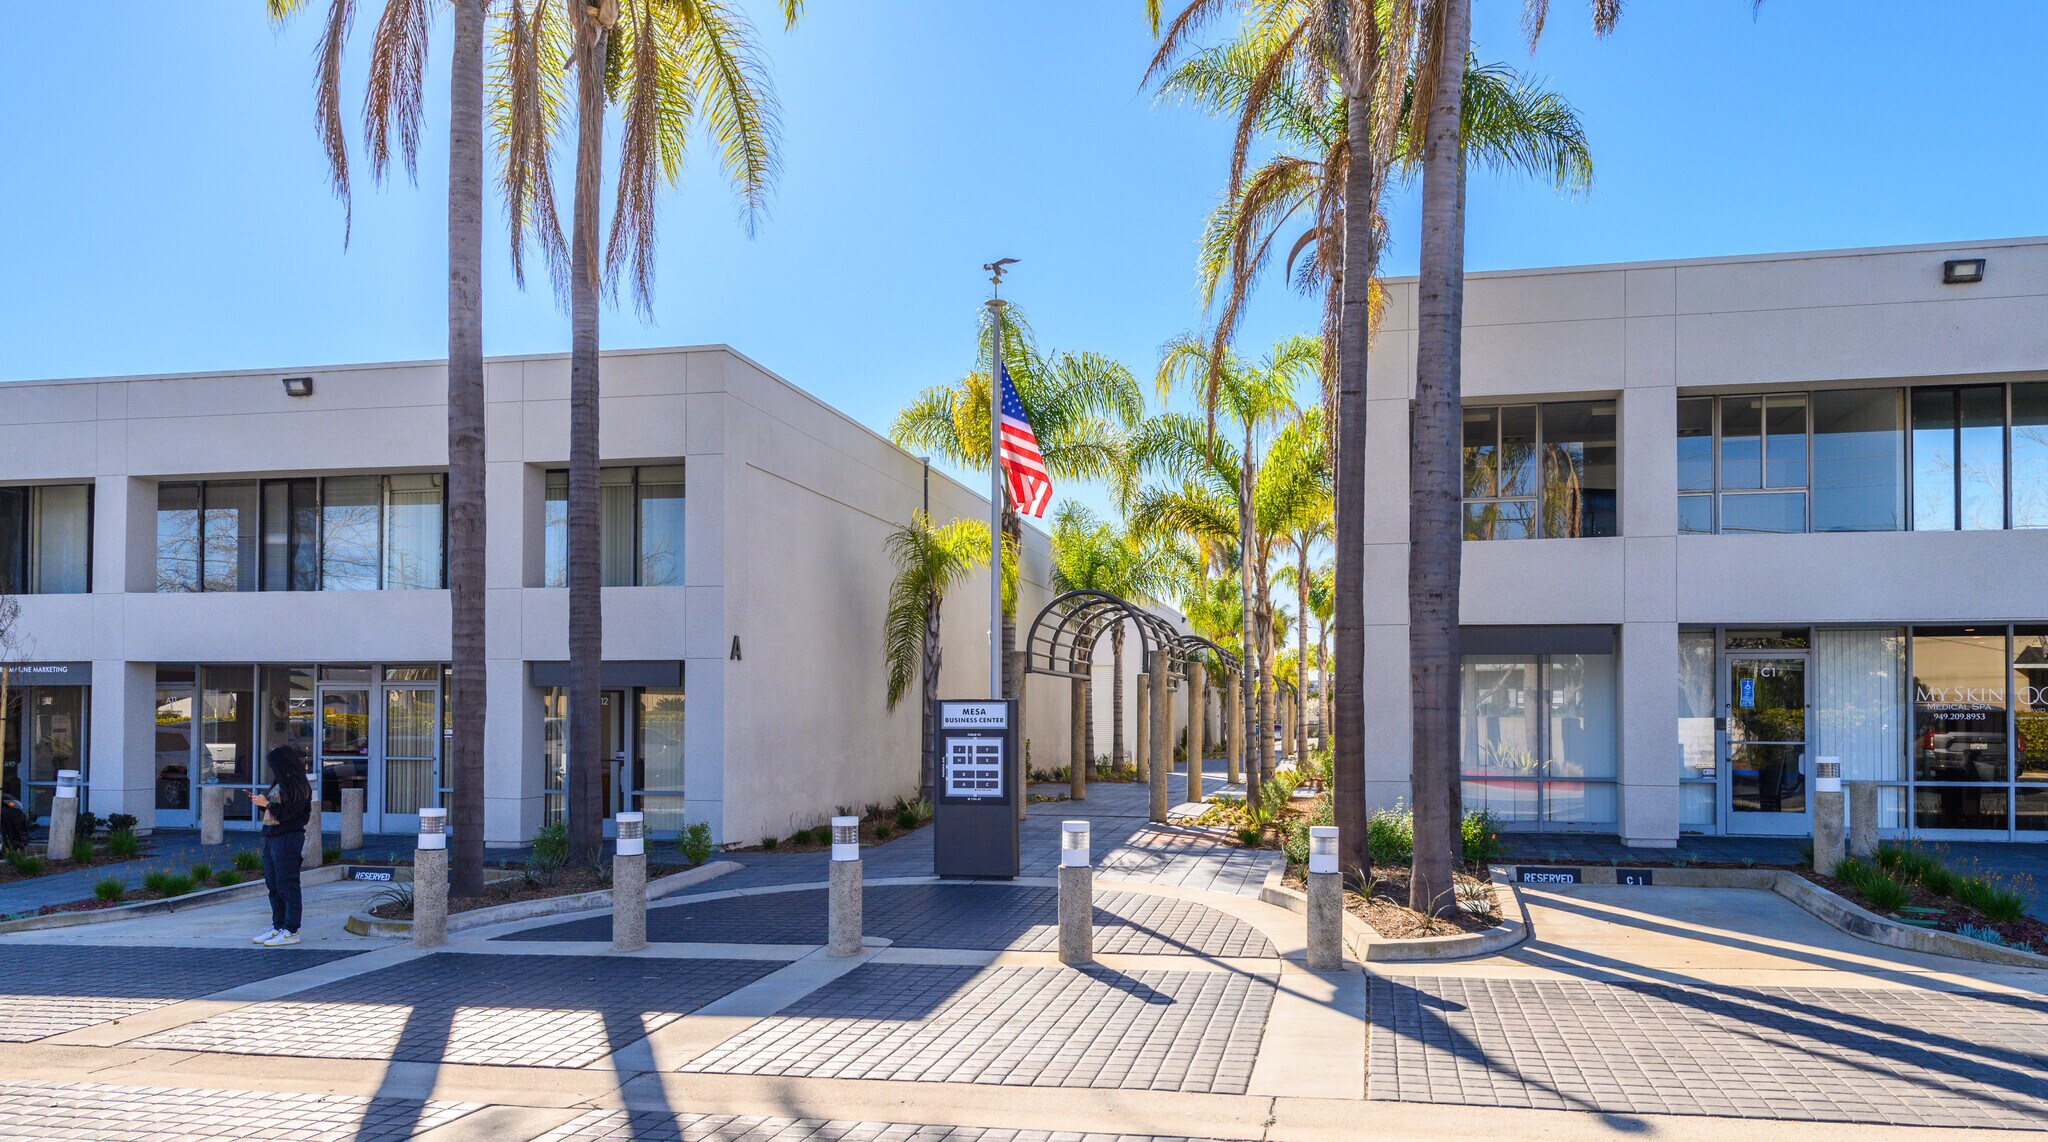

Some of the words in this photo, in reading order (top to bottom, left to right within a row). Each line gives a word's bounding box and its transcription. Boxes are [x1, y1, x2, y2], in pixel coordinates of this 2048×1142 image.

[730, 635, 742, 660] A
[1761, 667, 1776, 677] C1
[1916, 686, 1949, 702] MY
[1953, 685, 2003, 702] SKIN
[601, 697, 609, 705] 12
[1927, 703, 1968, 711] MEDICAL
[1971, 703, 1992, 711] SPA
[1933, 712, 1986, 720] 949.209.8953
[355, 871, 391, 881] RESERVED
[1523, 872, 1574, 884] RESERVED
[1626, 876, 1634, 885] C
[1638, 876, 1643, 886] 1
